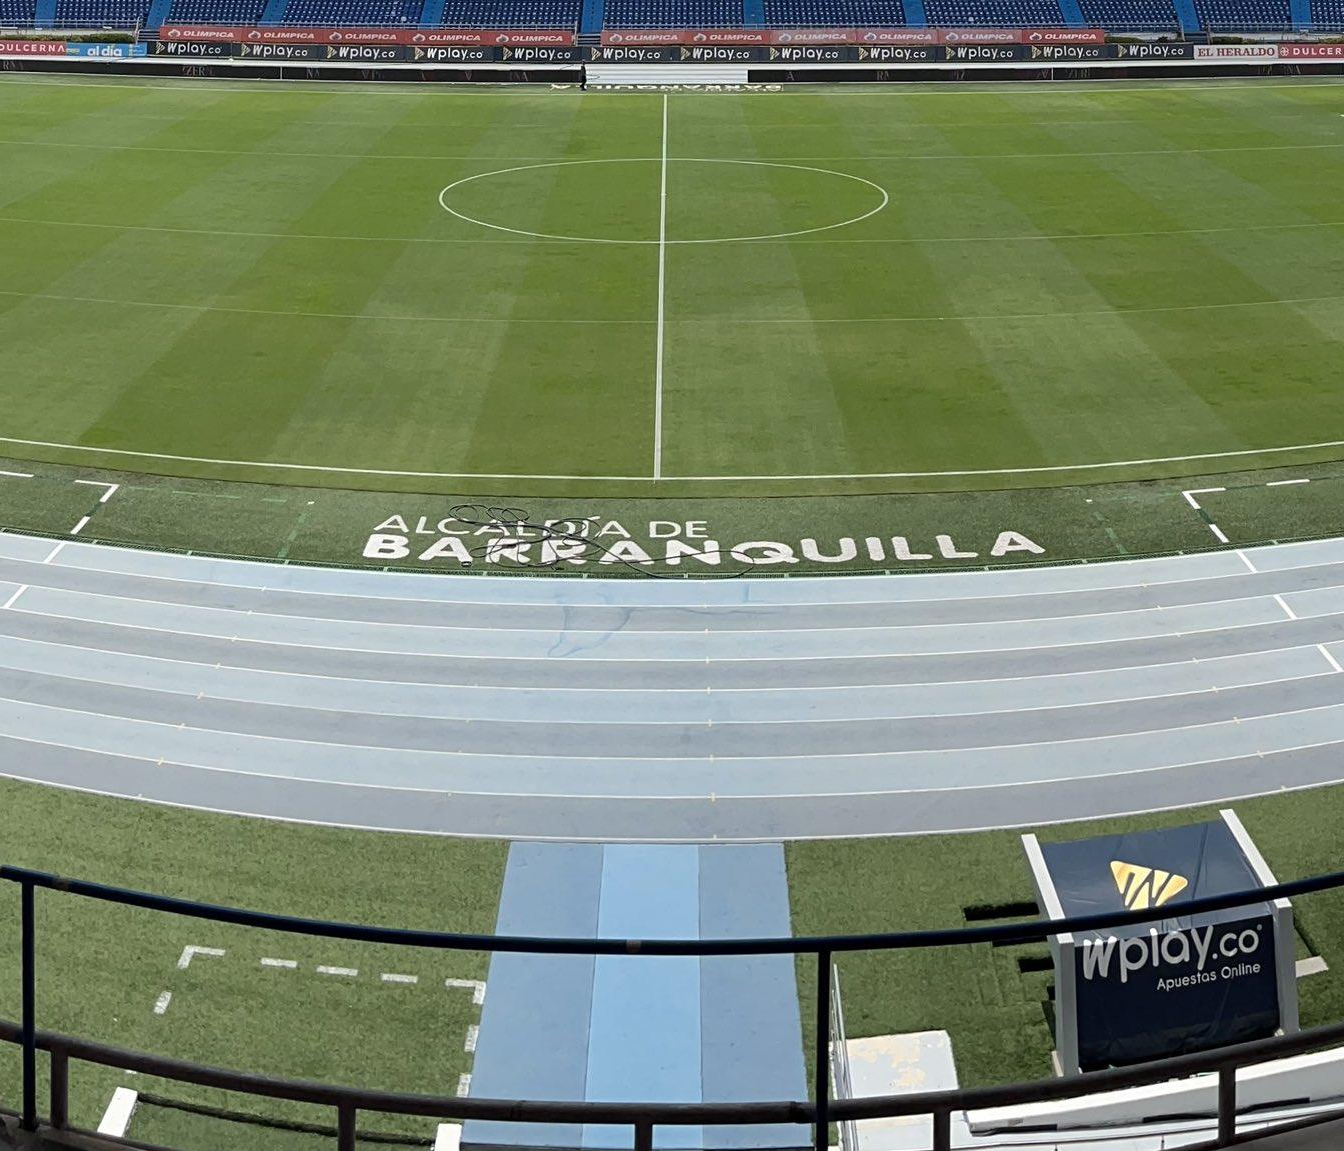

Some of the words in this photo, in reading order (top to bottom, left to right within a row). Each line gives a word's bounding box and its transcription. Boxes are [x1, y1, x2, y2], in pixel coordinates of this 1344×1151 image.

[184, 30, 234, 39] OLIMPICA
[264, 31, 314, 39] OLIMPICA
[345, 32, 397, 40] OLIMPICA
[429, 34, 481, 42] OLIMPICA
[1217, 47, 1275, 56] HERALDO
[649, 521, 708, 538] DE
[362, 531, 1046, 566] BARRANQUILLA
[1157, 969, 1218, 991] Apuestas
[1221, 962, 1261, 981] Online
